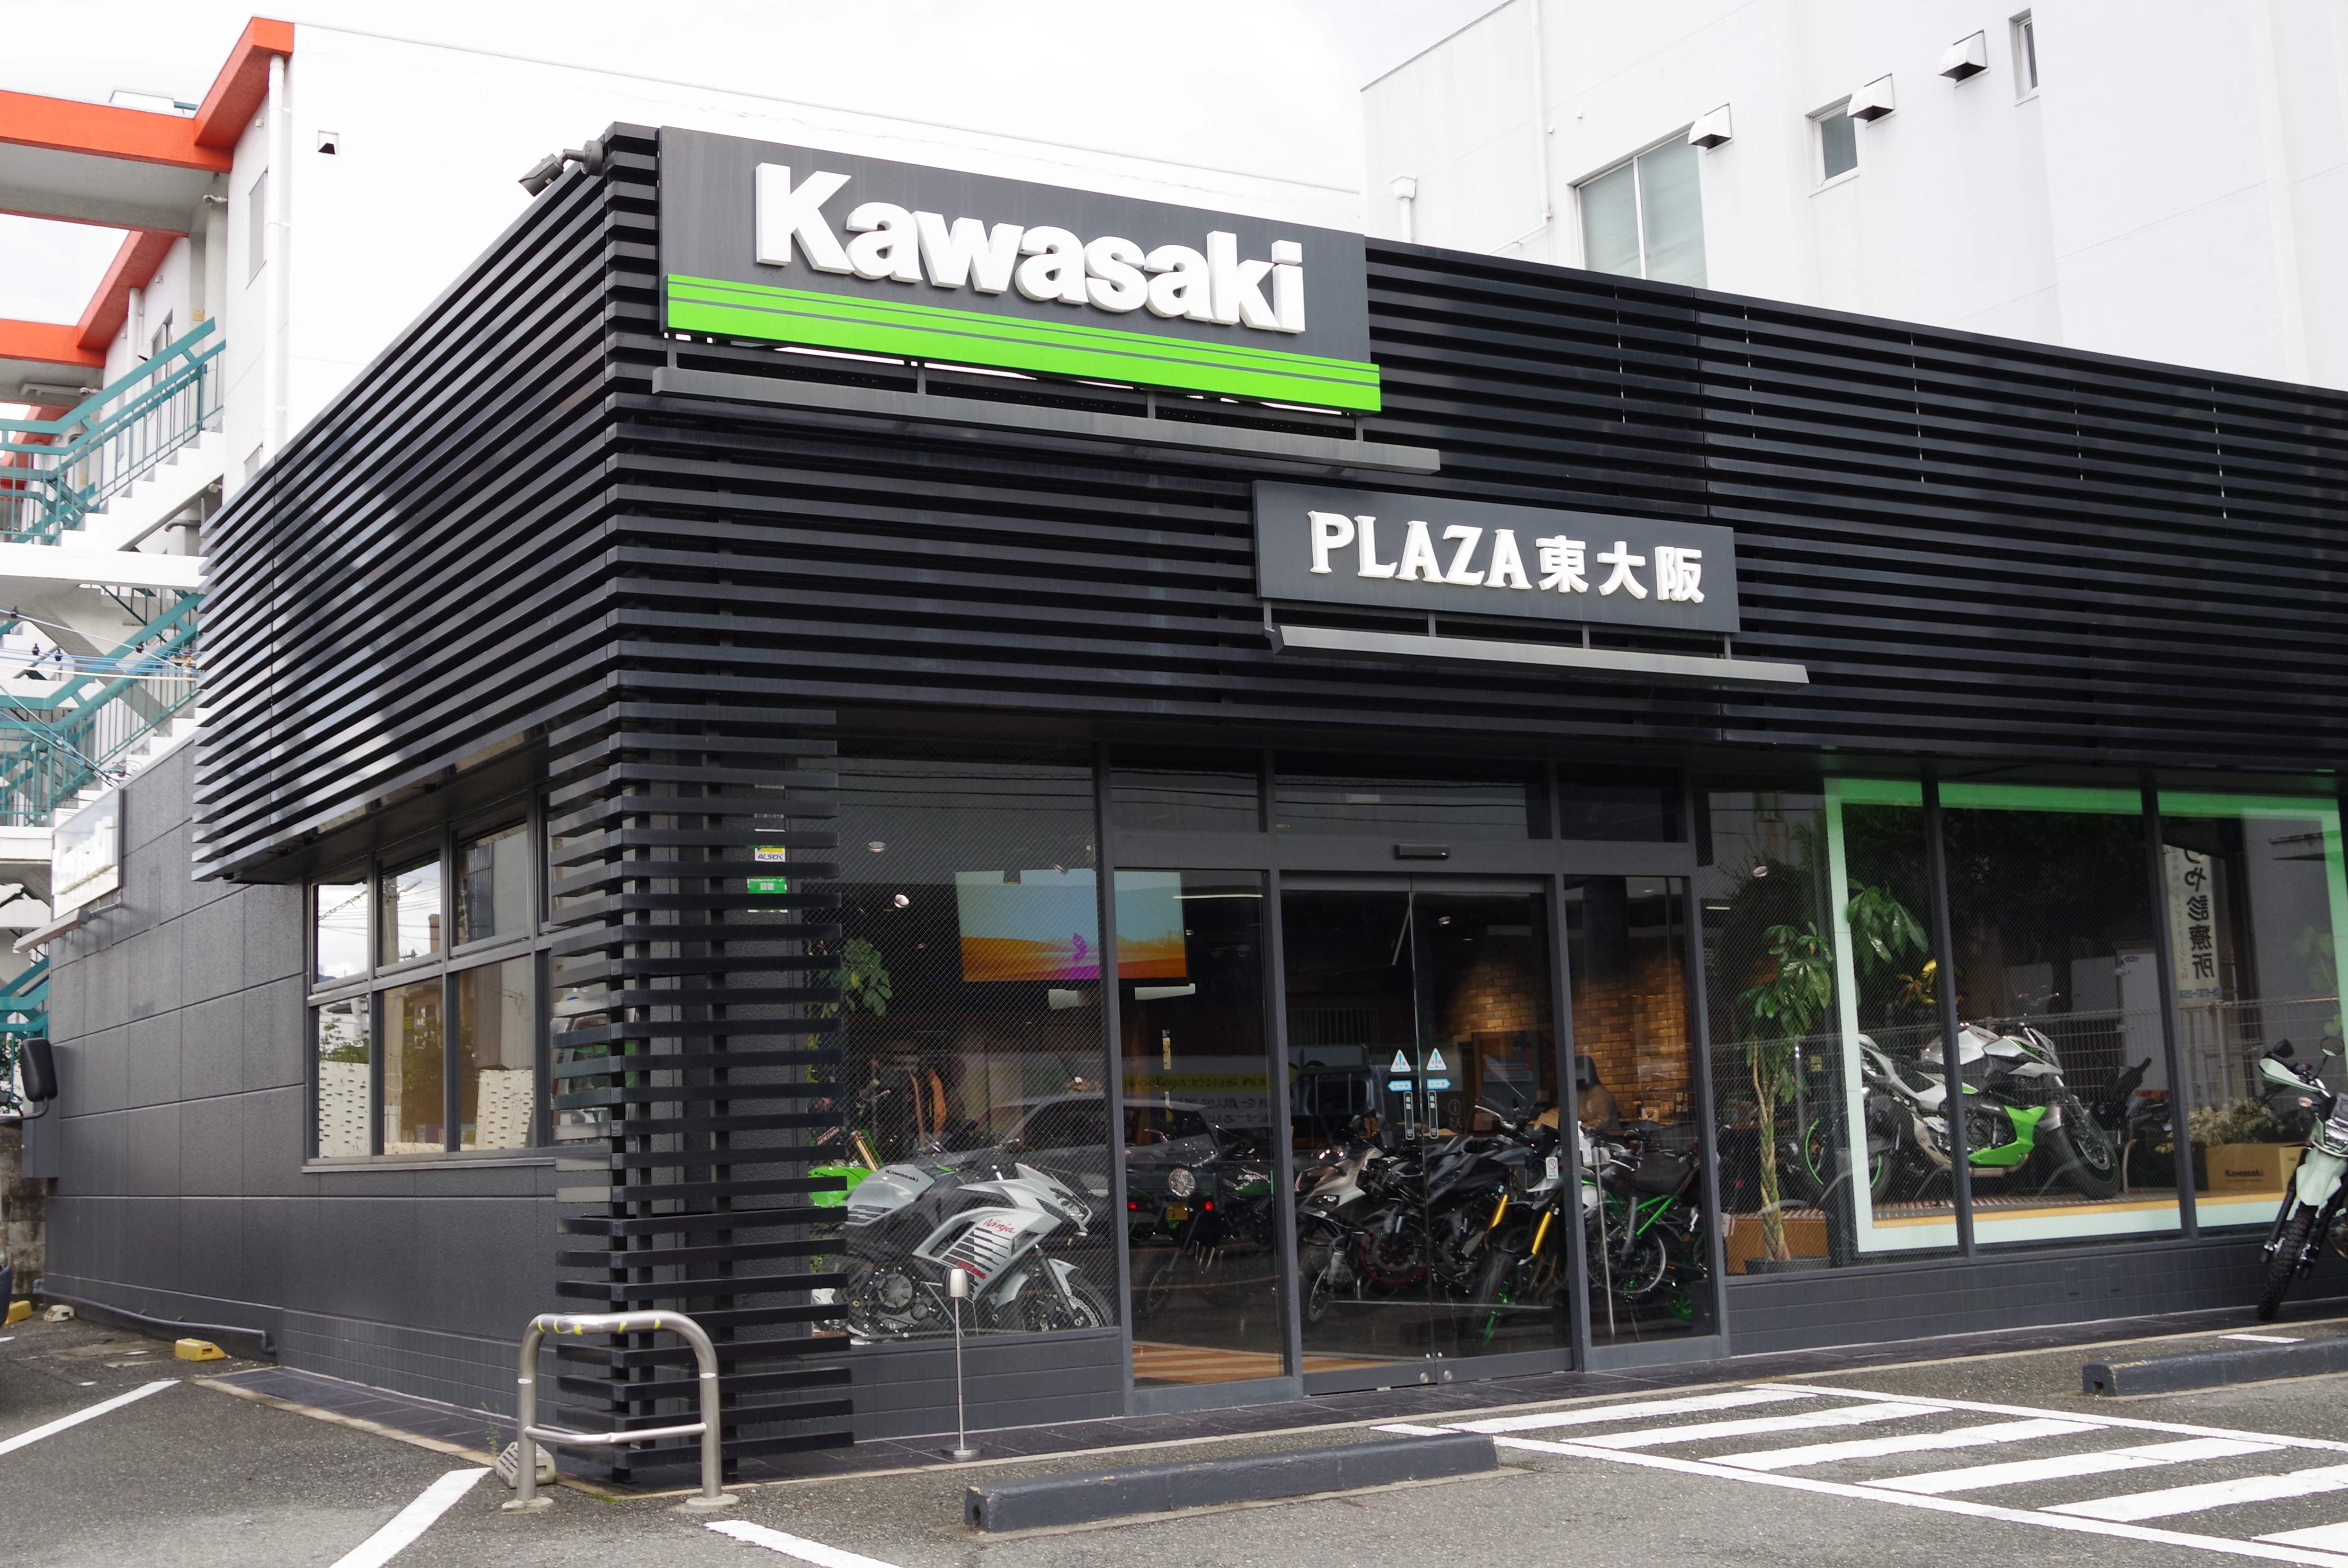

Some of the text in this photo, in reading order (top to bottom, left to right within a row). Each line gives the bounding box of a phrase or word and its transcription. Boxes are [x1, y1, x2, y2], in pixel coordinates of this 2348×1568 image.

[755, 162, 1305, 334] Kawasaki
[1307, 510, 1705, 604] PLAZA 東大阪
[885, 1169, 919, 1182] Kawasaki
[2225, 1168, 2264, 1177] Kawasaki
[983, 1218, 1015, 1234] Ninja
